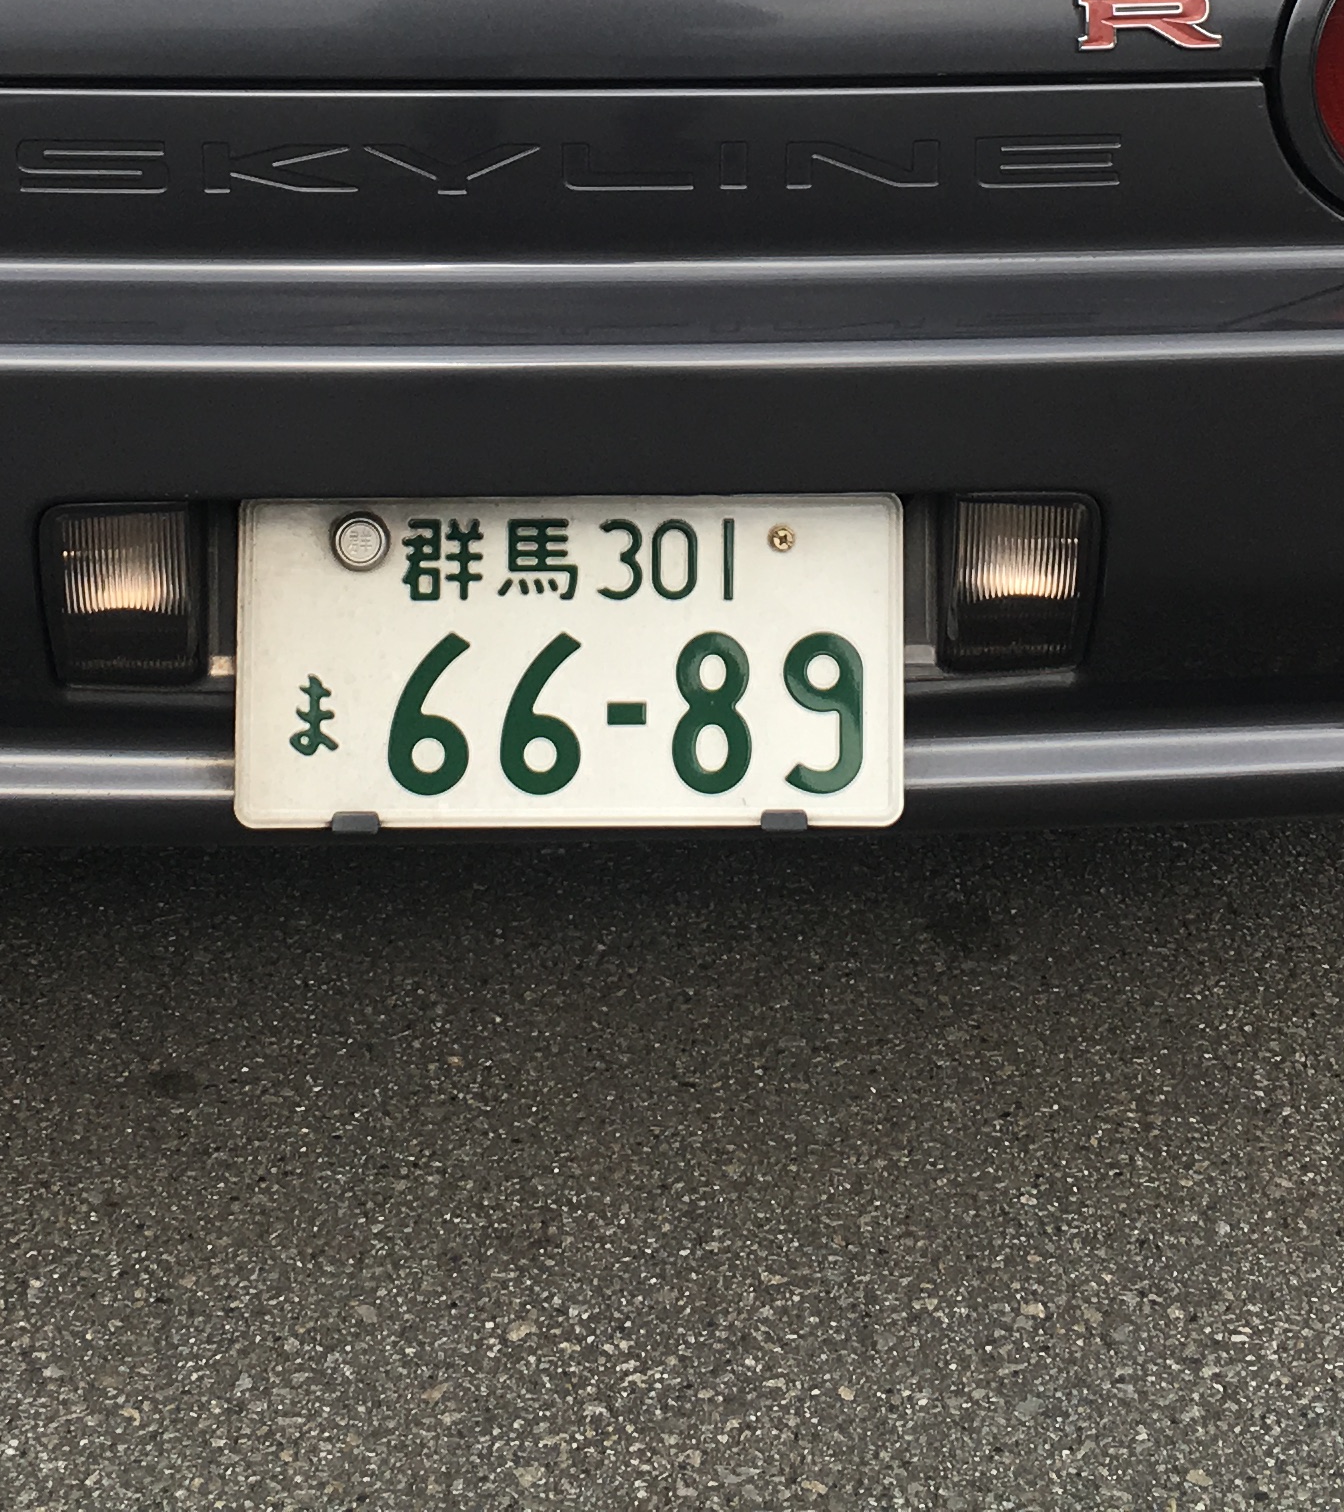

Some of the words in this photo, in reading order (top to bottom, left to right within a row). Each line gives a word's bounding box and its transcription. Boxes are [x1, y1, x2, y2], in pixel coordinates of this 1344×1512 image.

[16, 134, 1122, 196] SKYLINE
[402, 517, 579, 601] 群馬
[597, 517, 736, 601] 301
[289, 673, 339, 757] ま
[387, 631, 865, 797] 66-89
